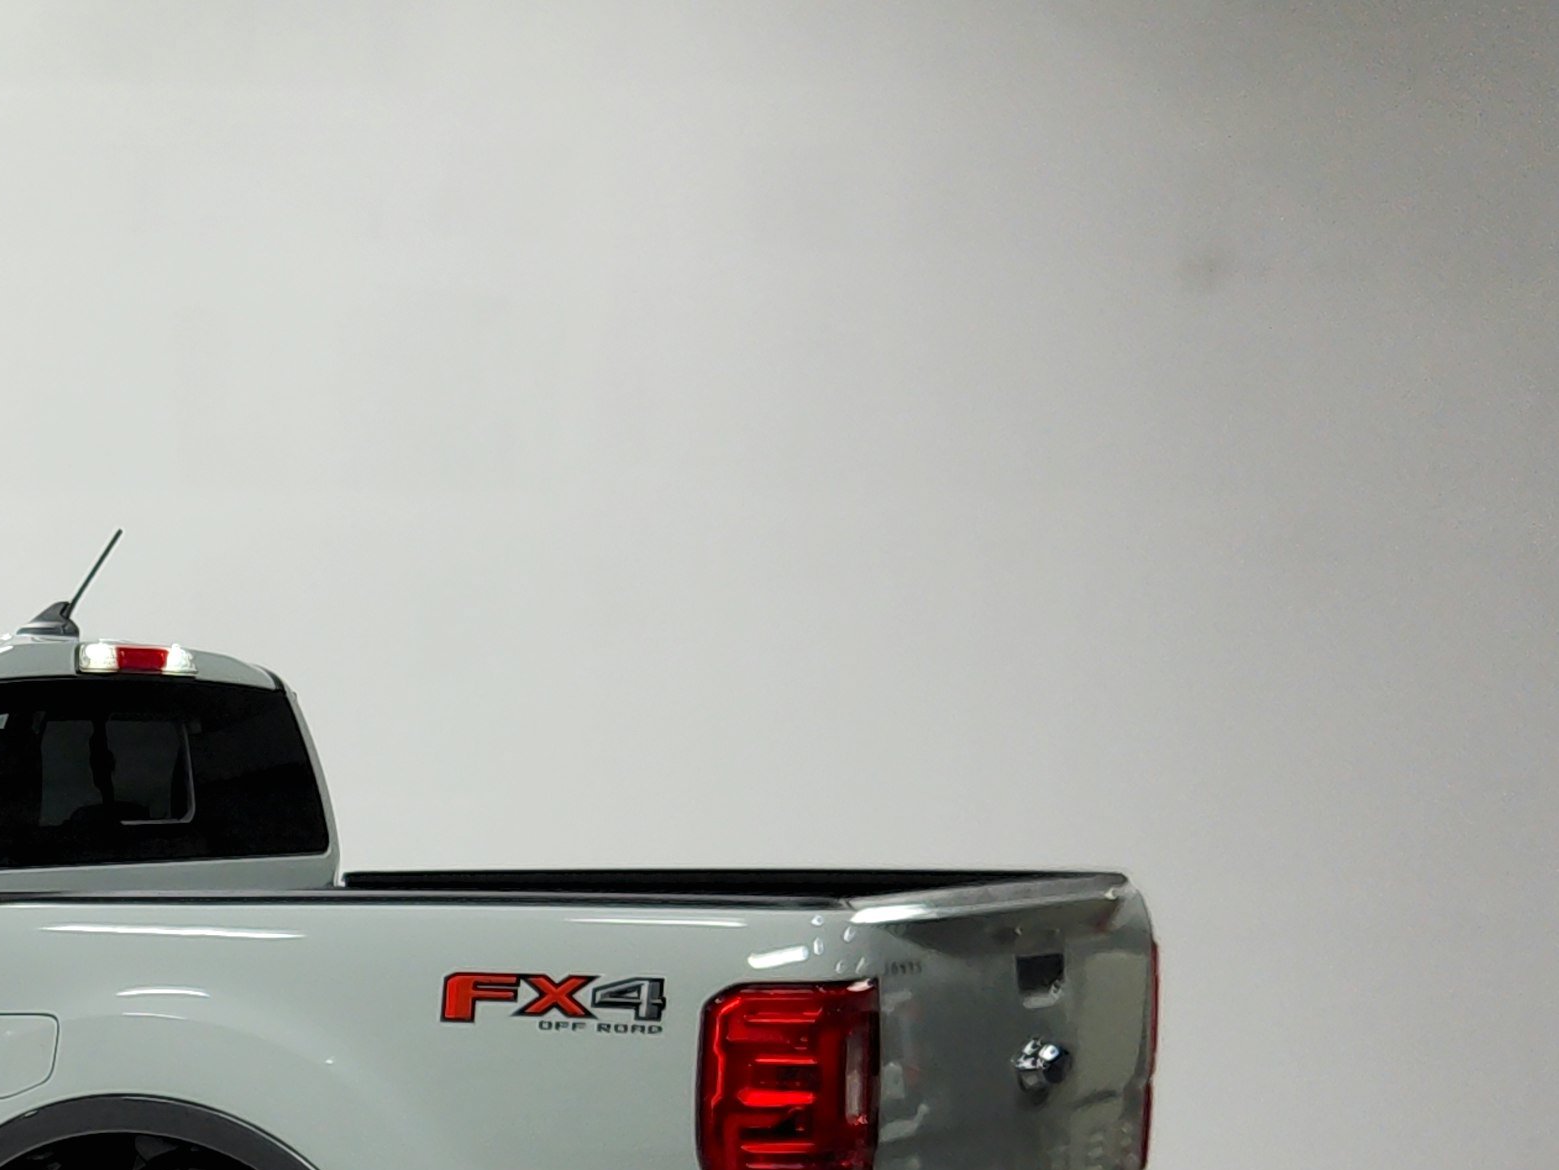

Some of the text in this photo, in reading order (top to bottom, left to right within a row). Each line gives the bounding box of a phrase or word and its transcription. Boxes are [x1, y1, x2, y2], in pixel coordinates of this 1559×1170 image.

[440, 972, 666, 1023] FX4
[538, 1020, 664, 1035] OFF ROAD
